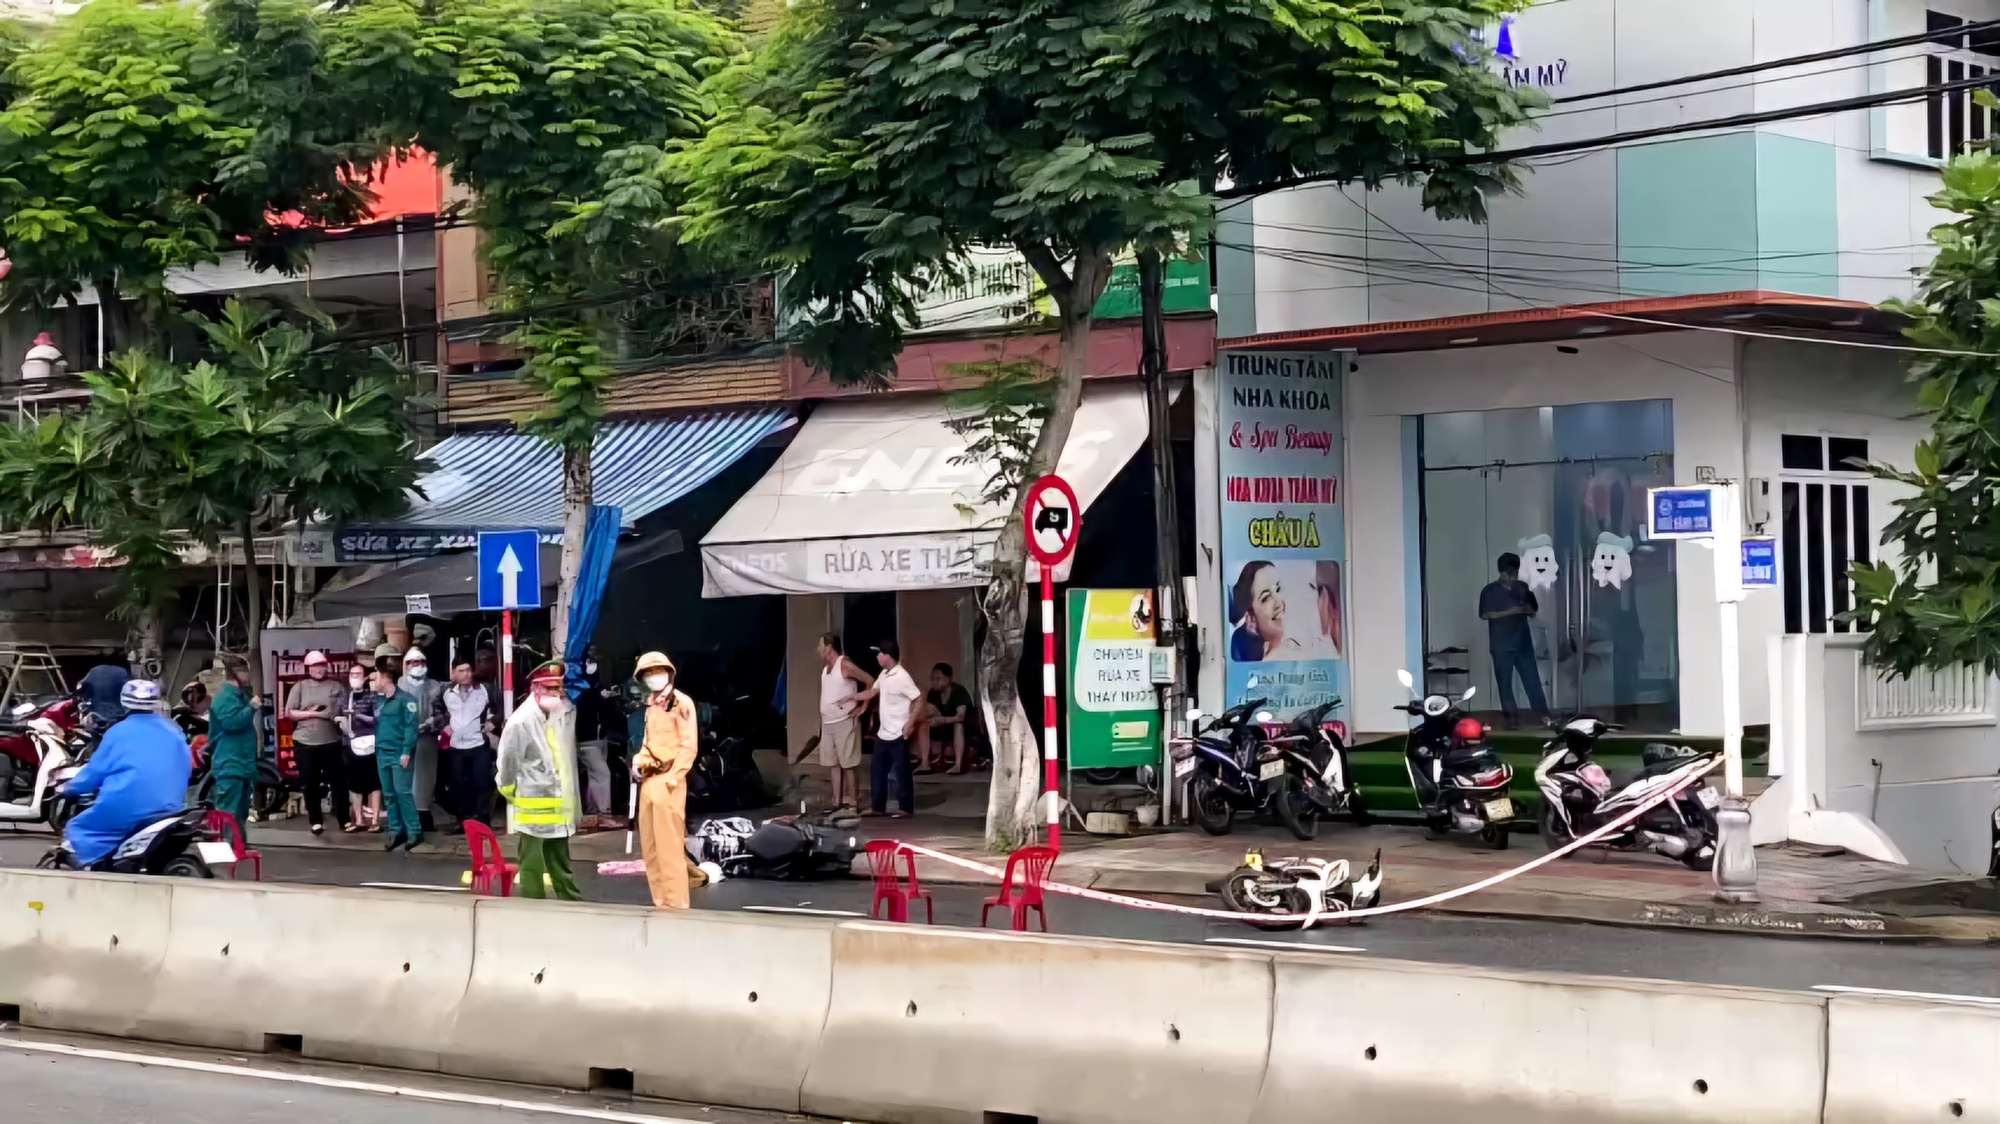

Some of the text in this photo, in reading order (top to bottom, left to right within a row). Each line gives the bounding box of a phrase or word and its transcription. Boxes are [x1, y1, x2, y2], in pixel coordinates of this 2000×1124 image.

[1227, 354, 1334, 379] TRUNG TÂM
[1233, 387, 1330, 411] NHA KHOA
[1248, 511, 1303, 548] CHÂU
[824, 541, 873, 574] RỬA
[880, 548, 912, 572] XE
